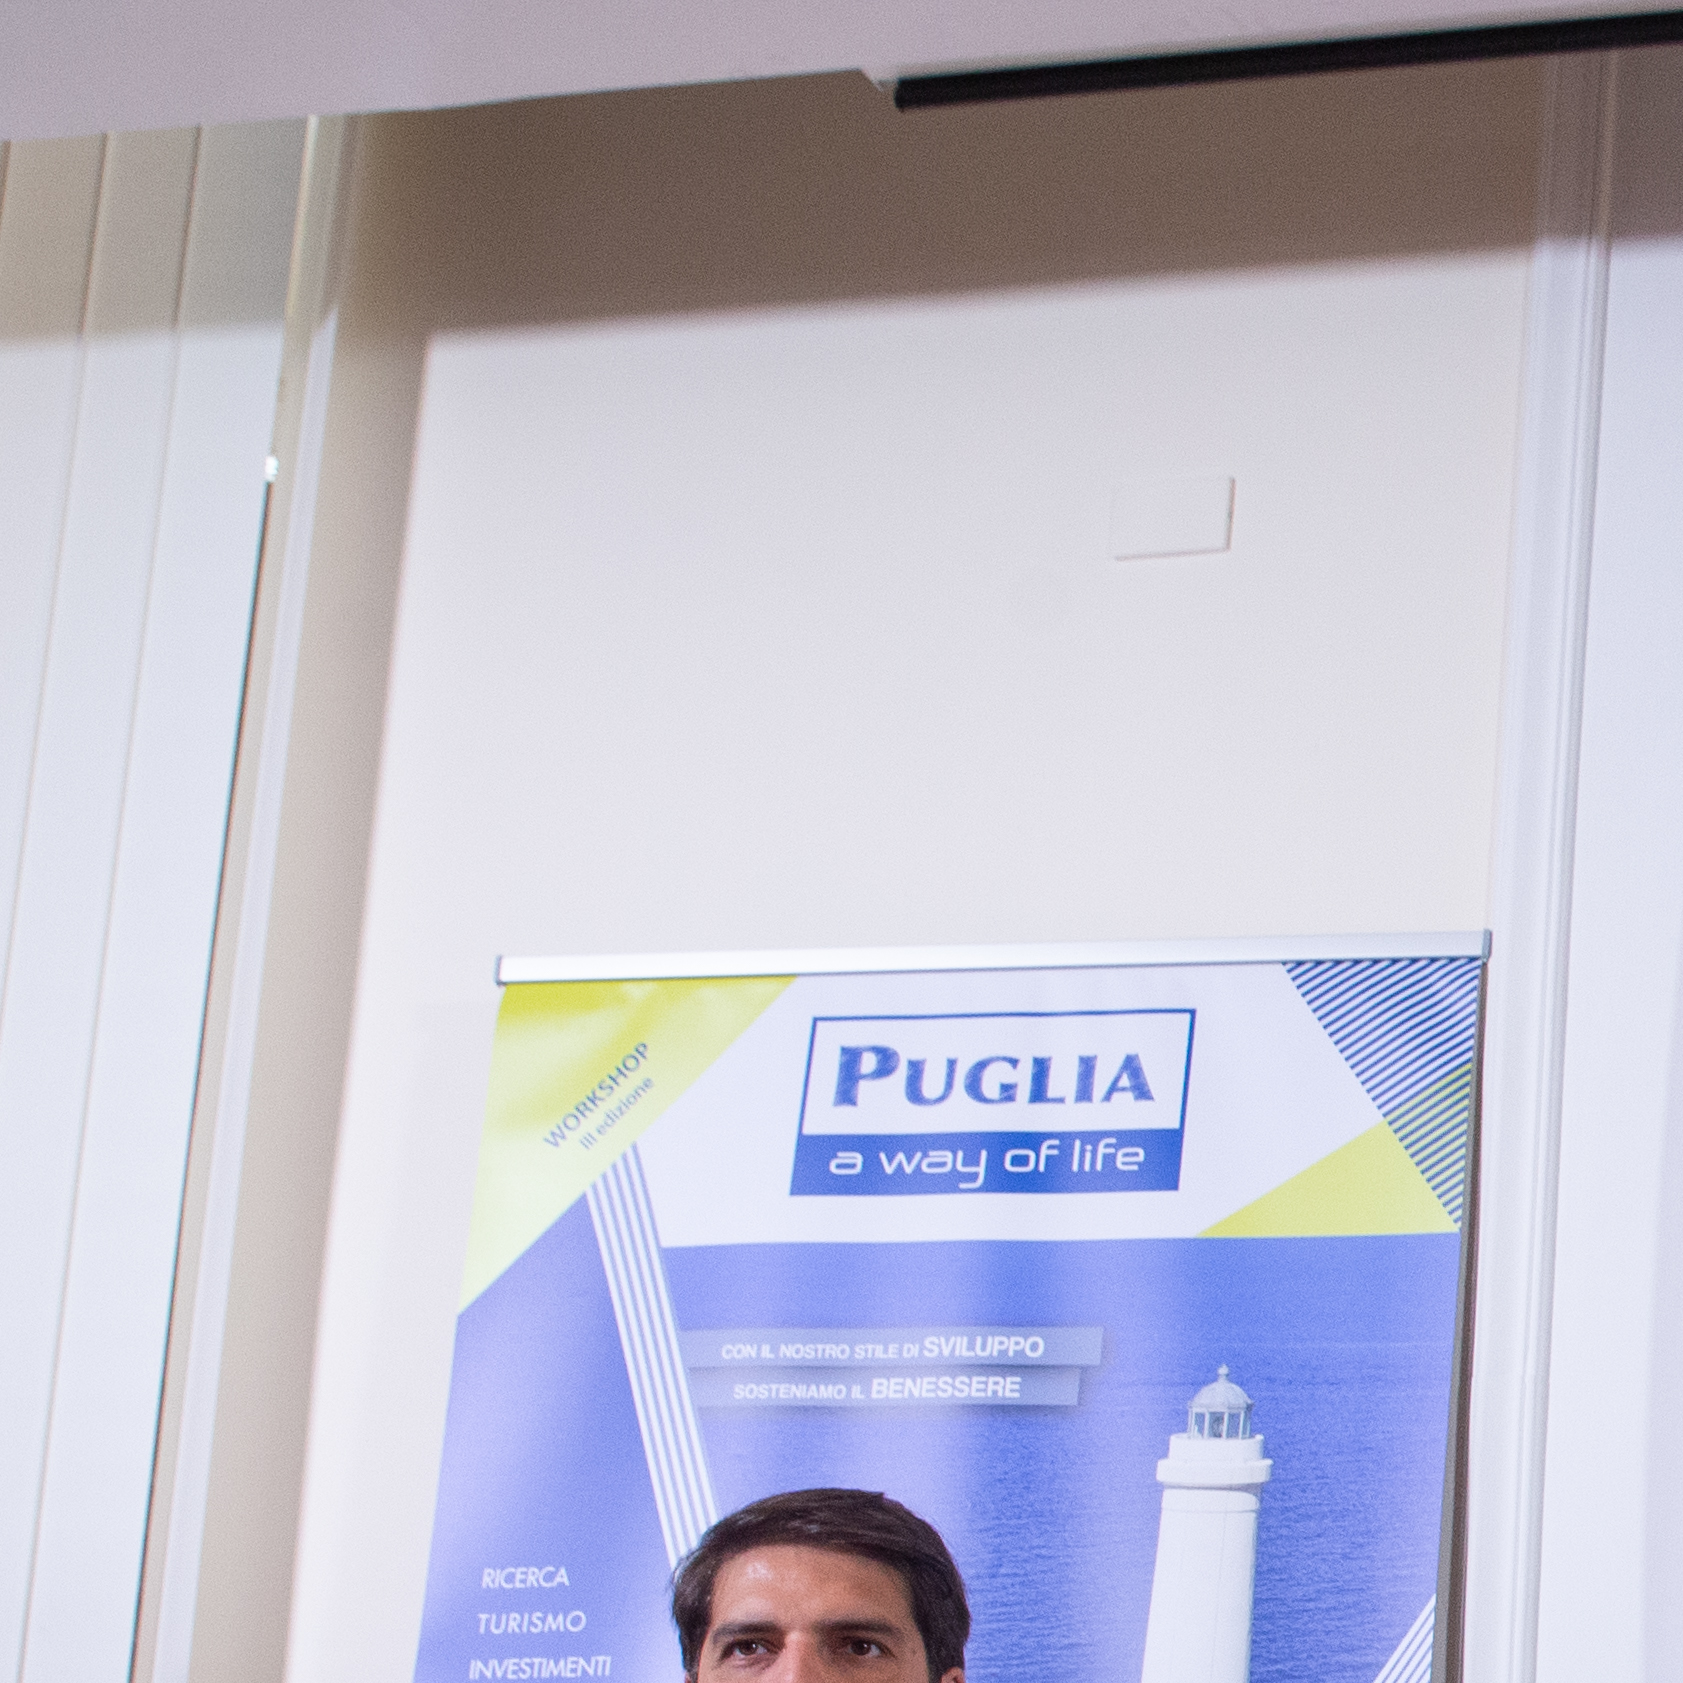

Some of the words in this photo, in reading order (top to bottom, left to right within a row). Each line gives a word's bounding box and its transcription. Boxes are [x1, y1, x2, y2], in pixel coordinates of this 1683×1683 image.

[833, 1045, 1155, 1106] PUGLIA
[543, 1041, 653, 1150] WORKSHOP
[594, 1074, 656, 1135] edizione
[829, 1144, 862, 1176] a
[879, 1144, 990, 1188] way
[1004, 1139, 1060, 1174] of
[1072, 1139, 1145, 1173] life
[722, 1344, 756, 1358] CON
[761, 1345, 775, 1358] IL
[780, 1344, 850, 1358] NOSTRO
[855, 1345, 900, 1358] STILE
[903, 1344, 919, 1357] DI
[923, 1335, 1044, 1358] SVILUPPO
[733, 1384, 847, 1400] SOSTENIAMO
[851, 1385, 865, 1399] IL
[871, 1376, 1021, 1399] BENESSERE
[481, 1567, 569, 1589] RICERCA
[478, 1610, 587, 1634] TURISMO
[469, 1656, 612, 1680] INVESTIMENTI
